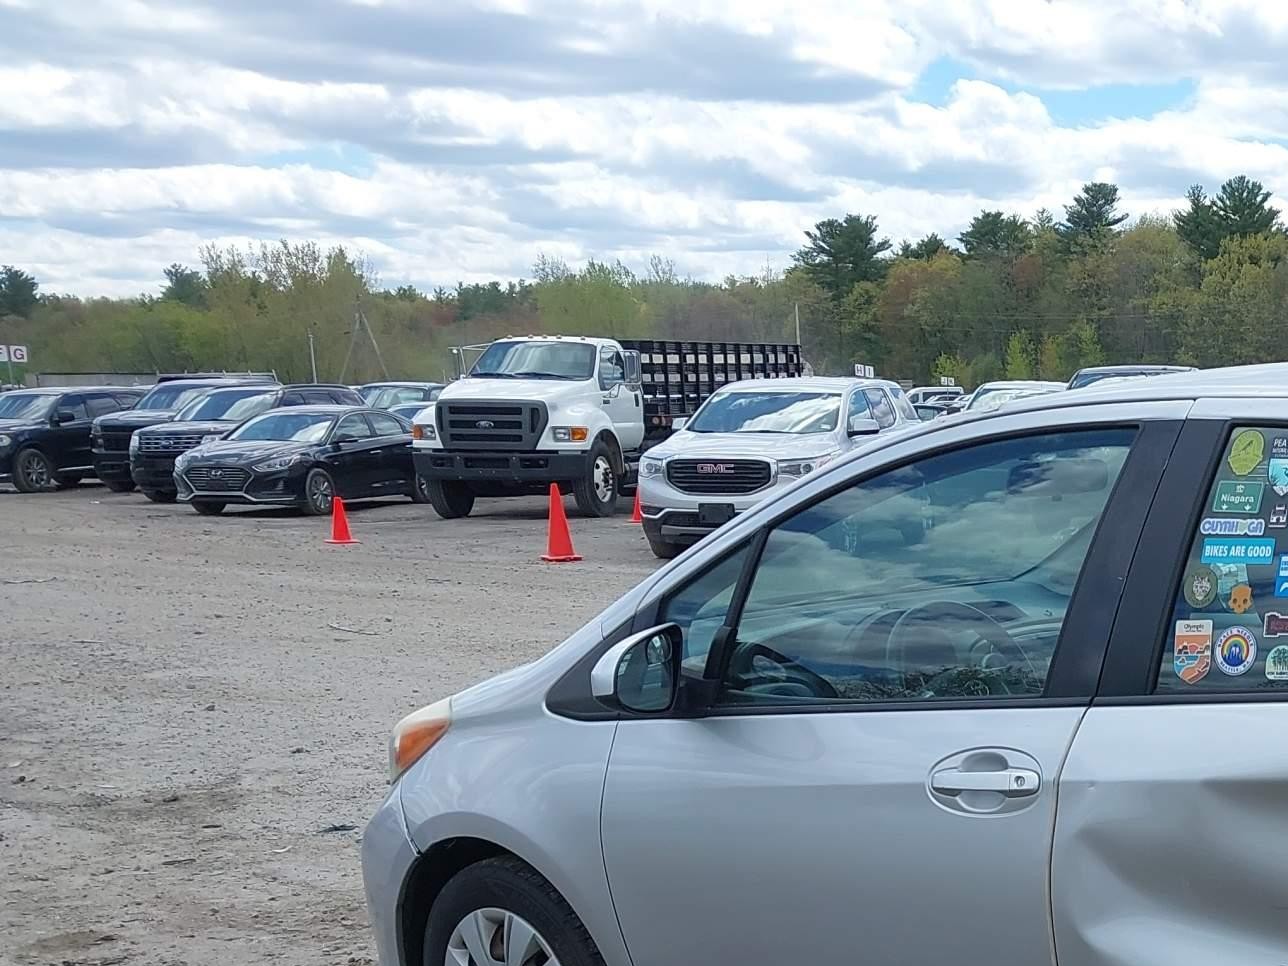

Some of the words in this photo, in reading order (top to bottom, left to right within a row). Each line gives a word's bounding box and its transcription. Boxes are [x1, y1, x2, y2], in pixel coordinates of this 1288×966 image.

[13, 348, 25, 360] G
[1273, 438, 1287, 448] PEA
[696, 463, 735, 474] GMC
[1220, 494, 1255, 504] Niagara
[1205, 545, 1228, 557] BIKES
[1228, 546, 1245, 557] ARE
[1247, 546, 1272, 557] GOOD
[1183, 623, 1205, 631] Olympic
